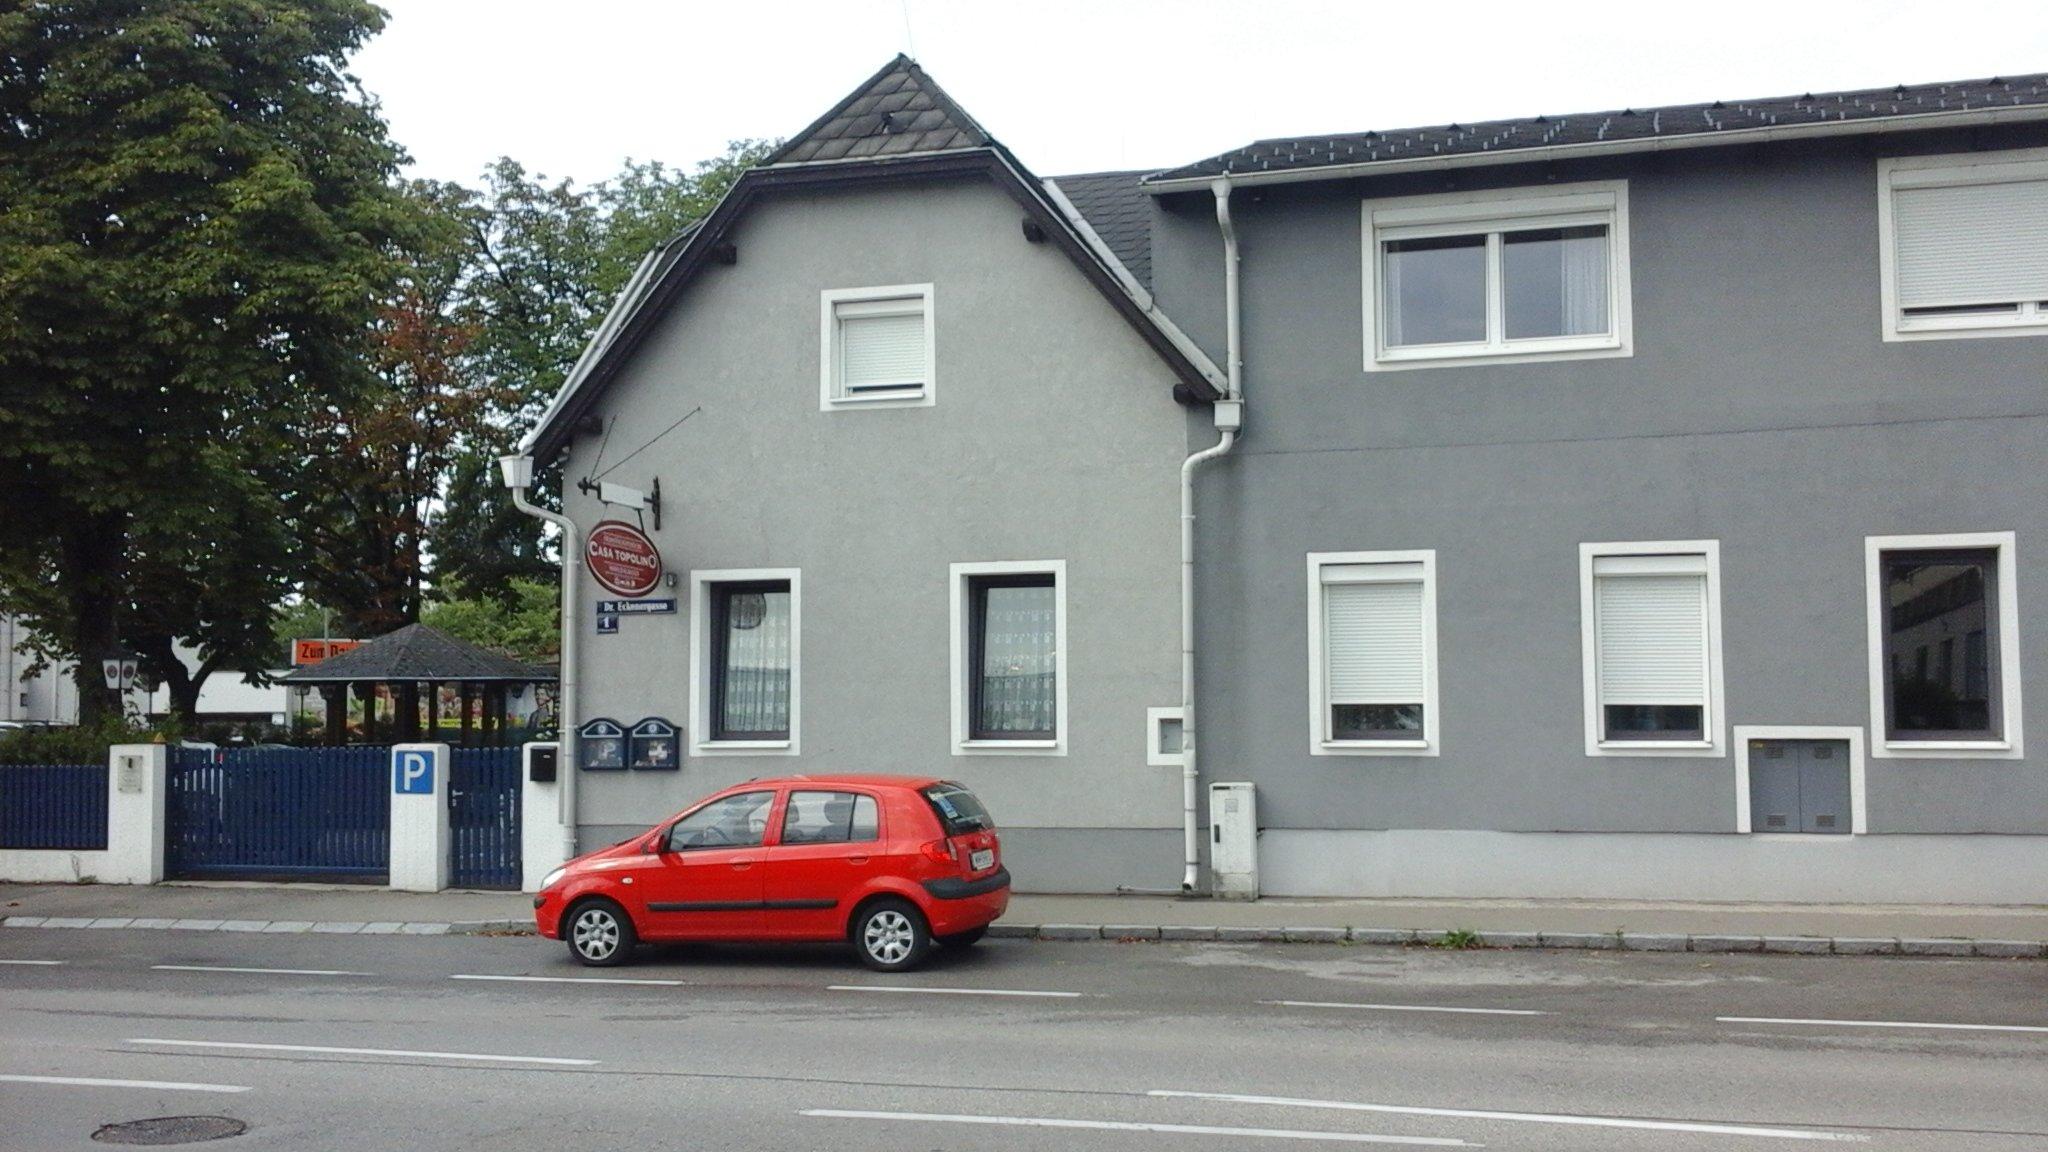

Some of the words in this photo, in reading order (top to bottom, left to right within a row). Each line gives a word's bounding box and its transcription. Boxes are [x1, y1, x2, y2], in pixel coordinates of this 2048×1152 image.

[589, 541, 614, 560] CASA
[614, 550, 656, 569] TOPOLINO
[603, 616, 610, 628] 1
[404, 753, 426, 791] P
